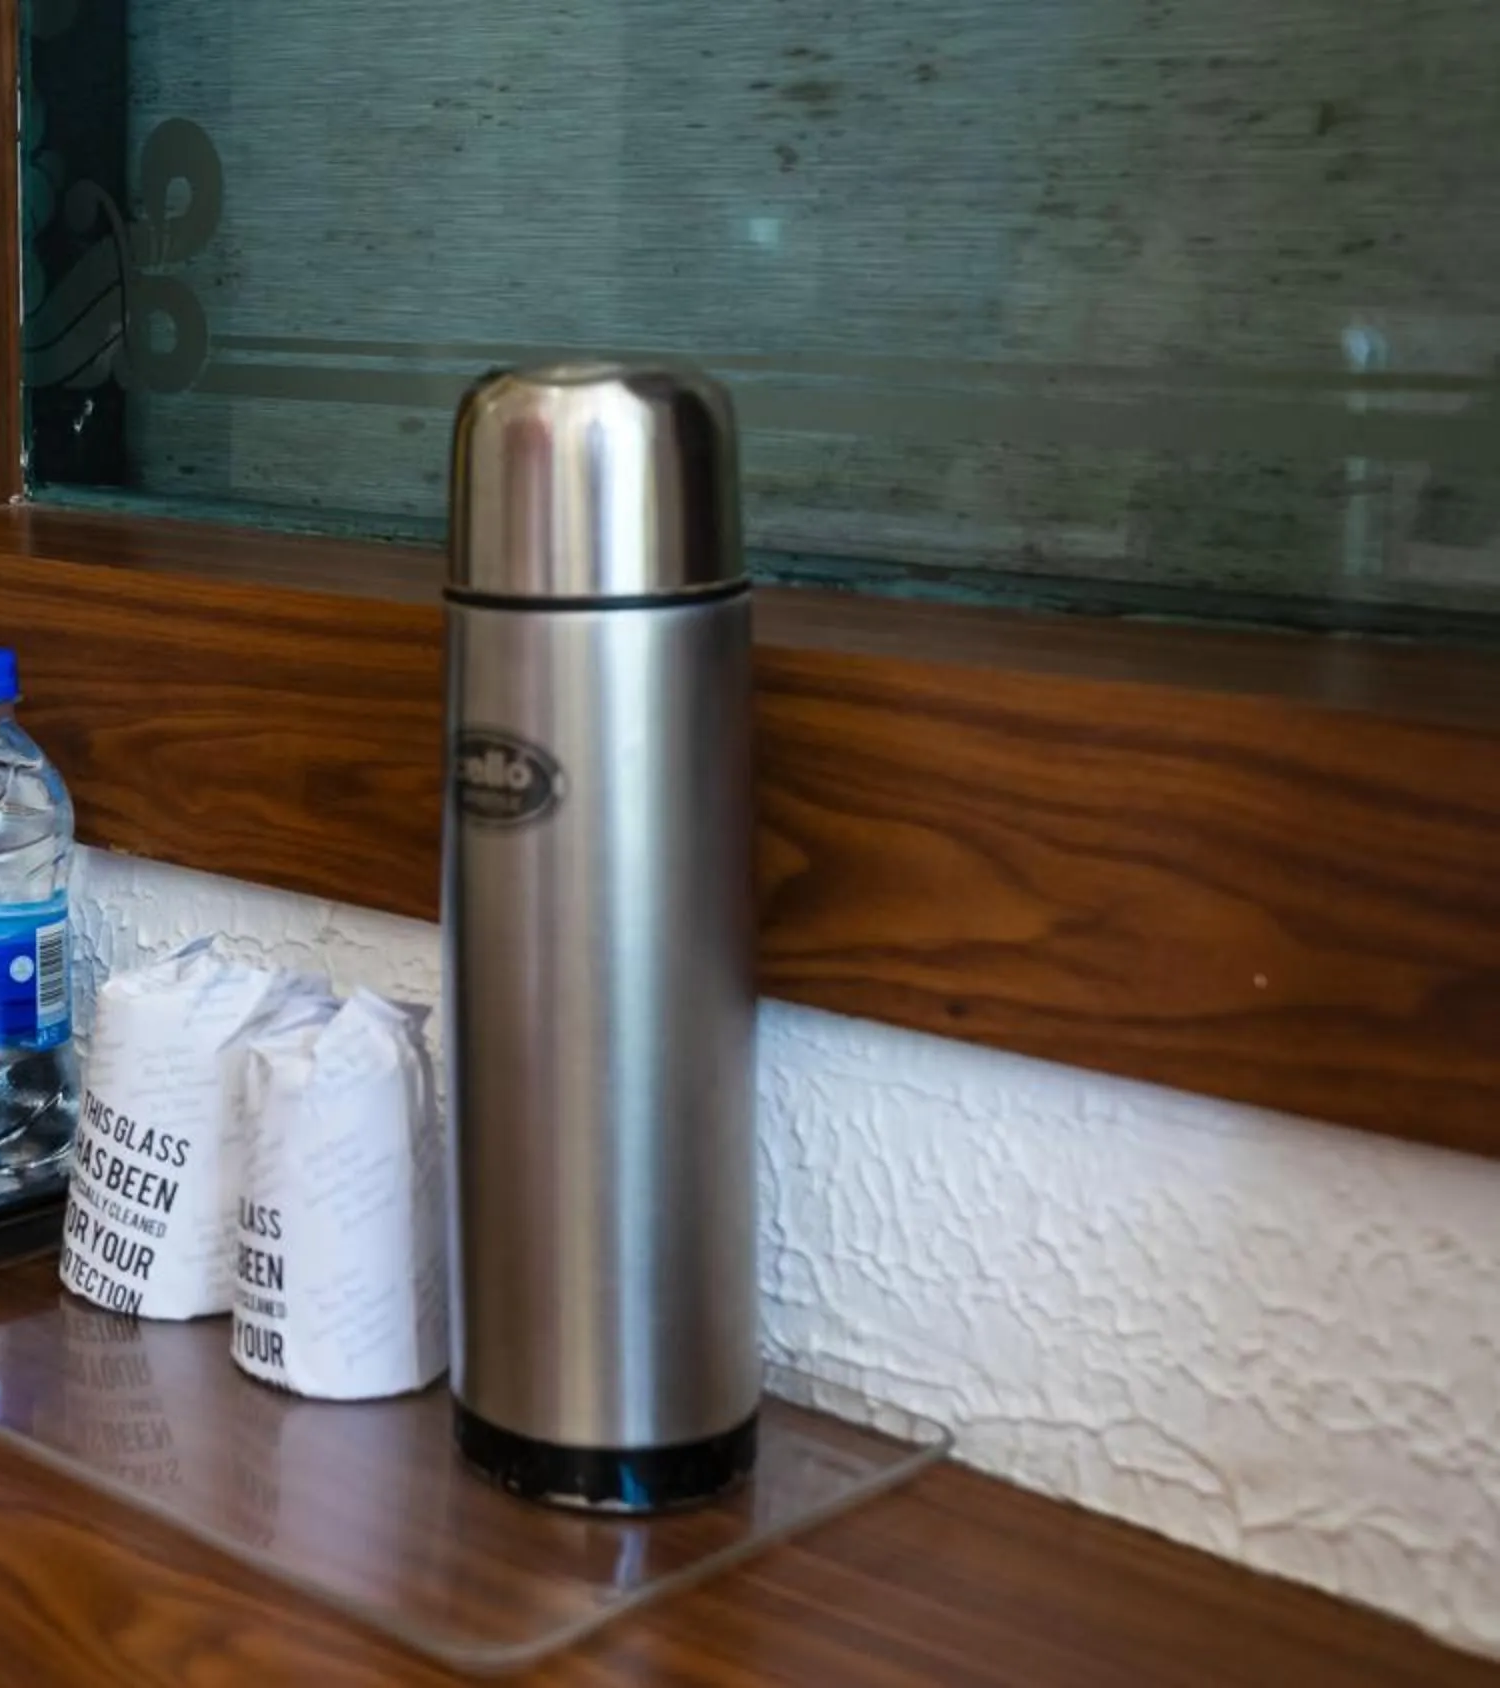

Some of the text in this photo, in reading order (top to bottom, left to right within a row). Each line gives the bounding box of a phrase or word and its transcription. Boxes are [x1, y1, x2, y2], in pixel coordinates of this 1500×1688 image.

[83, 1088, 115, 1136] THIS
[113, 1114, 190, 1168] GLASS
[106, 1157, 179, 1214] BEEN
[107, 1201, 168, 1239] CLEANED
[91, 1219, 155, 1281] YOUR
[236, 1319, 285, 1369] YOUR
